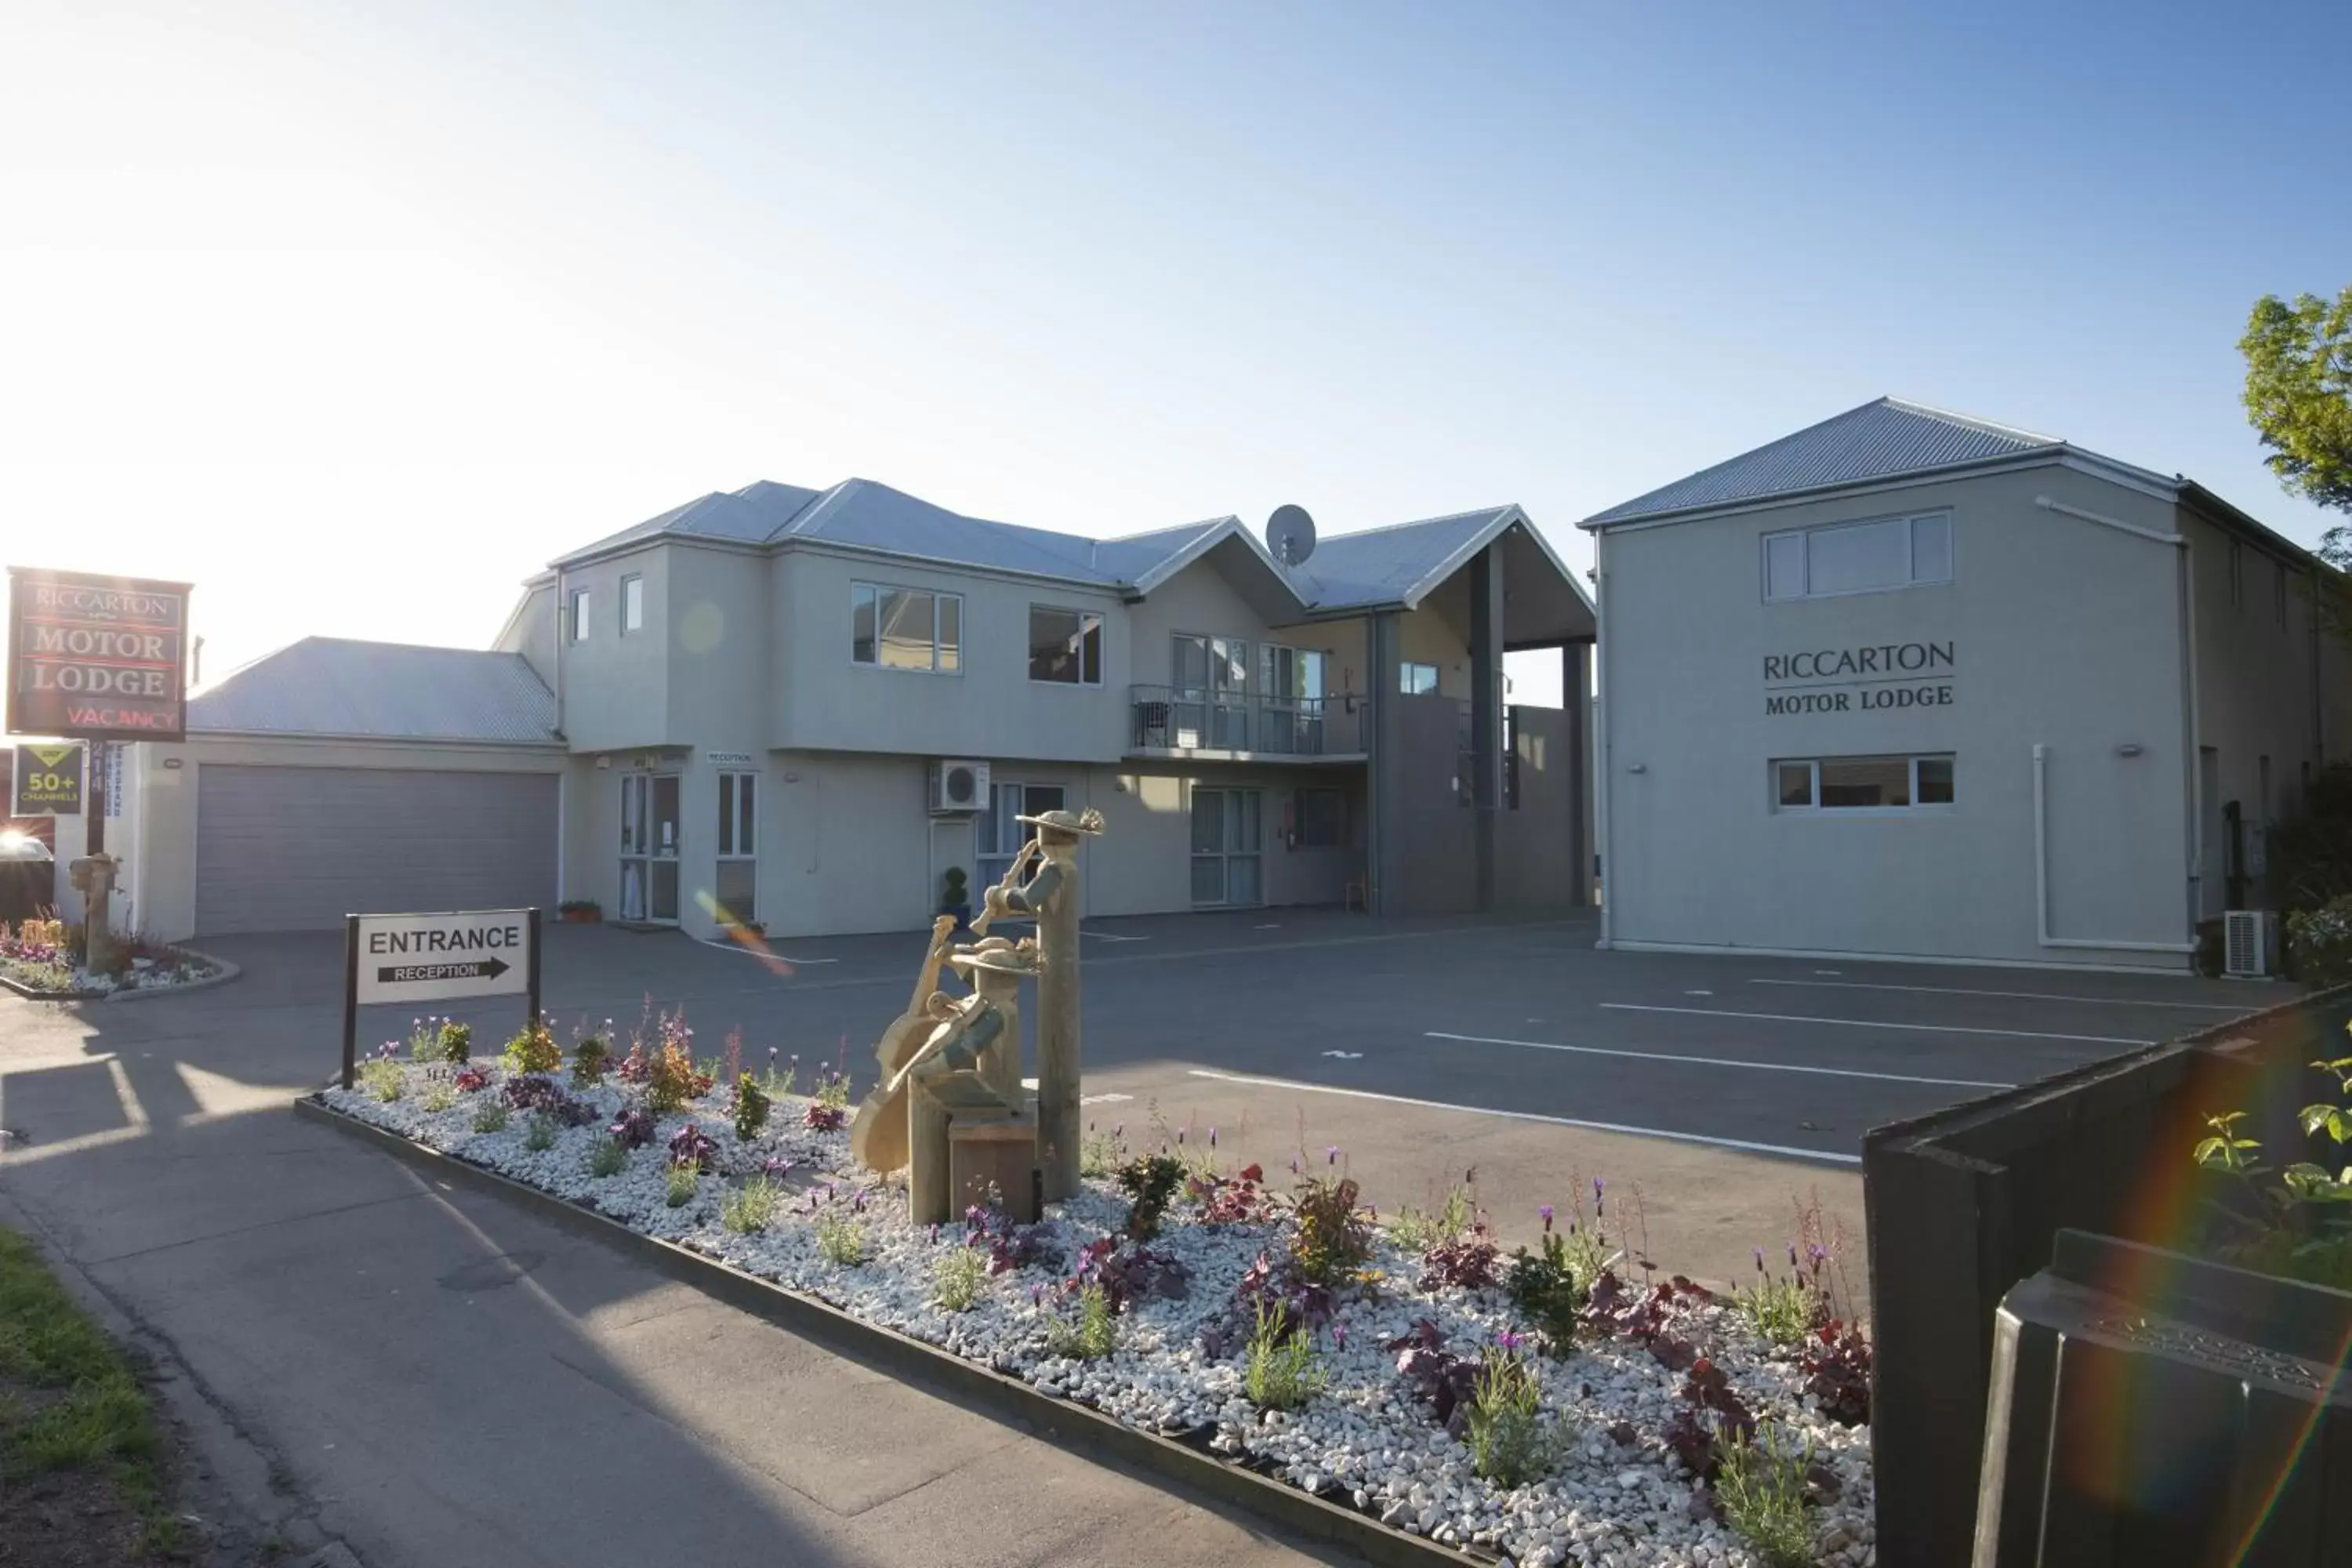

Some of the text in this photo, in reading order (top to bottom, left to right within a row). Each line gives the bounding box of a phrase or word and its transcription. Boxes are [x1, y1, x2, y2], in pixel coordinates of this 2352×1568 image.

[36, 588, 168, 615] RICCARTON
[33, 626, 167, 659] MOTOR
[1763, 641, 1955, 681] RICCARTON
[32, 664, 166, 696] LODGE
[1766, 686, 1955, 715] MOTOR LODGE
[67, 706, 176, 728] VACANCY
[28, 773, 75, 792] 50+
[369, 927, 519, 953] ENTRANCE
[394, 964, 479, 981] RECEPTION
